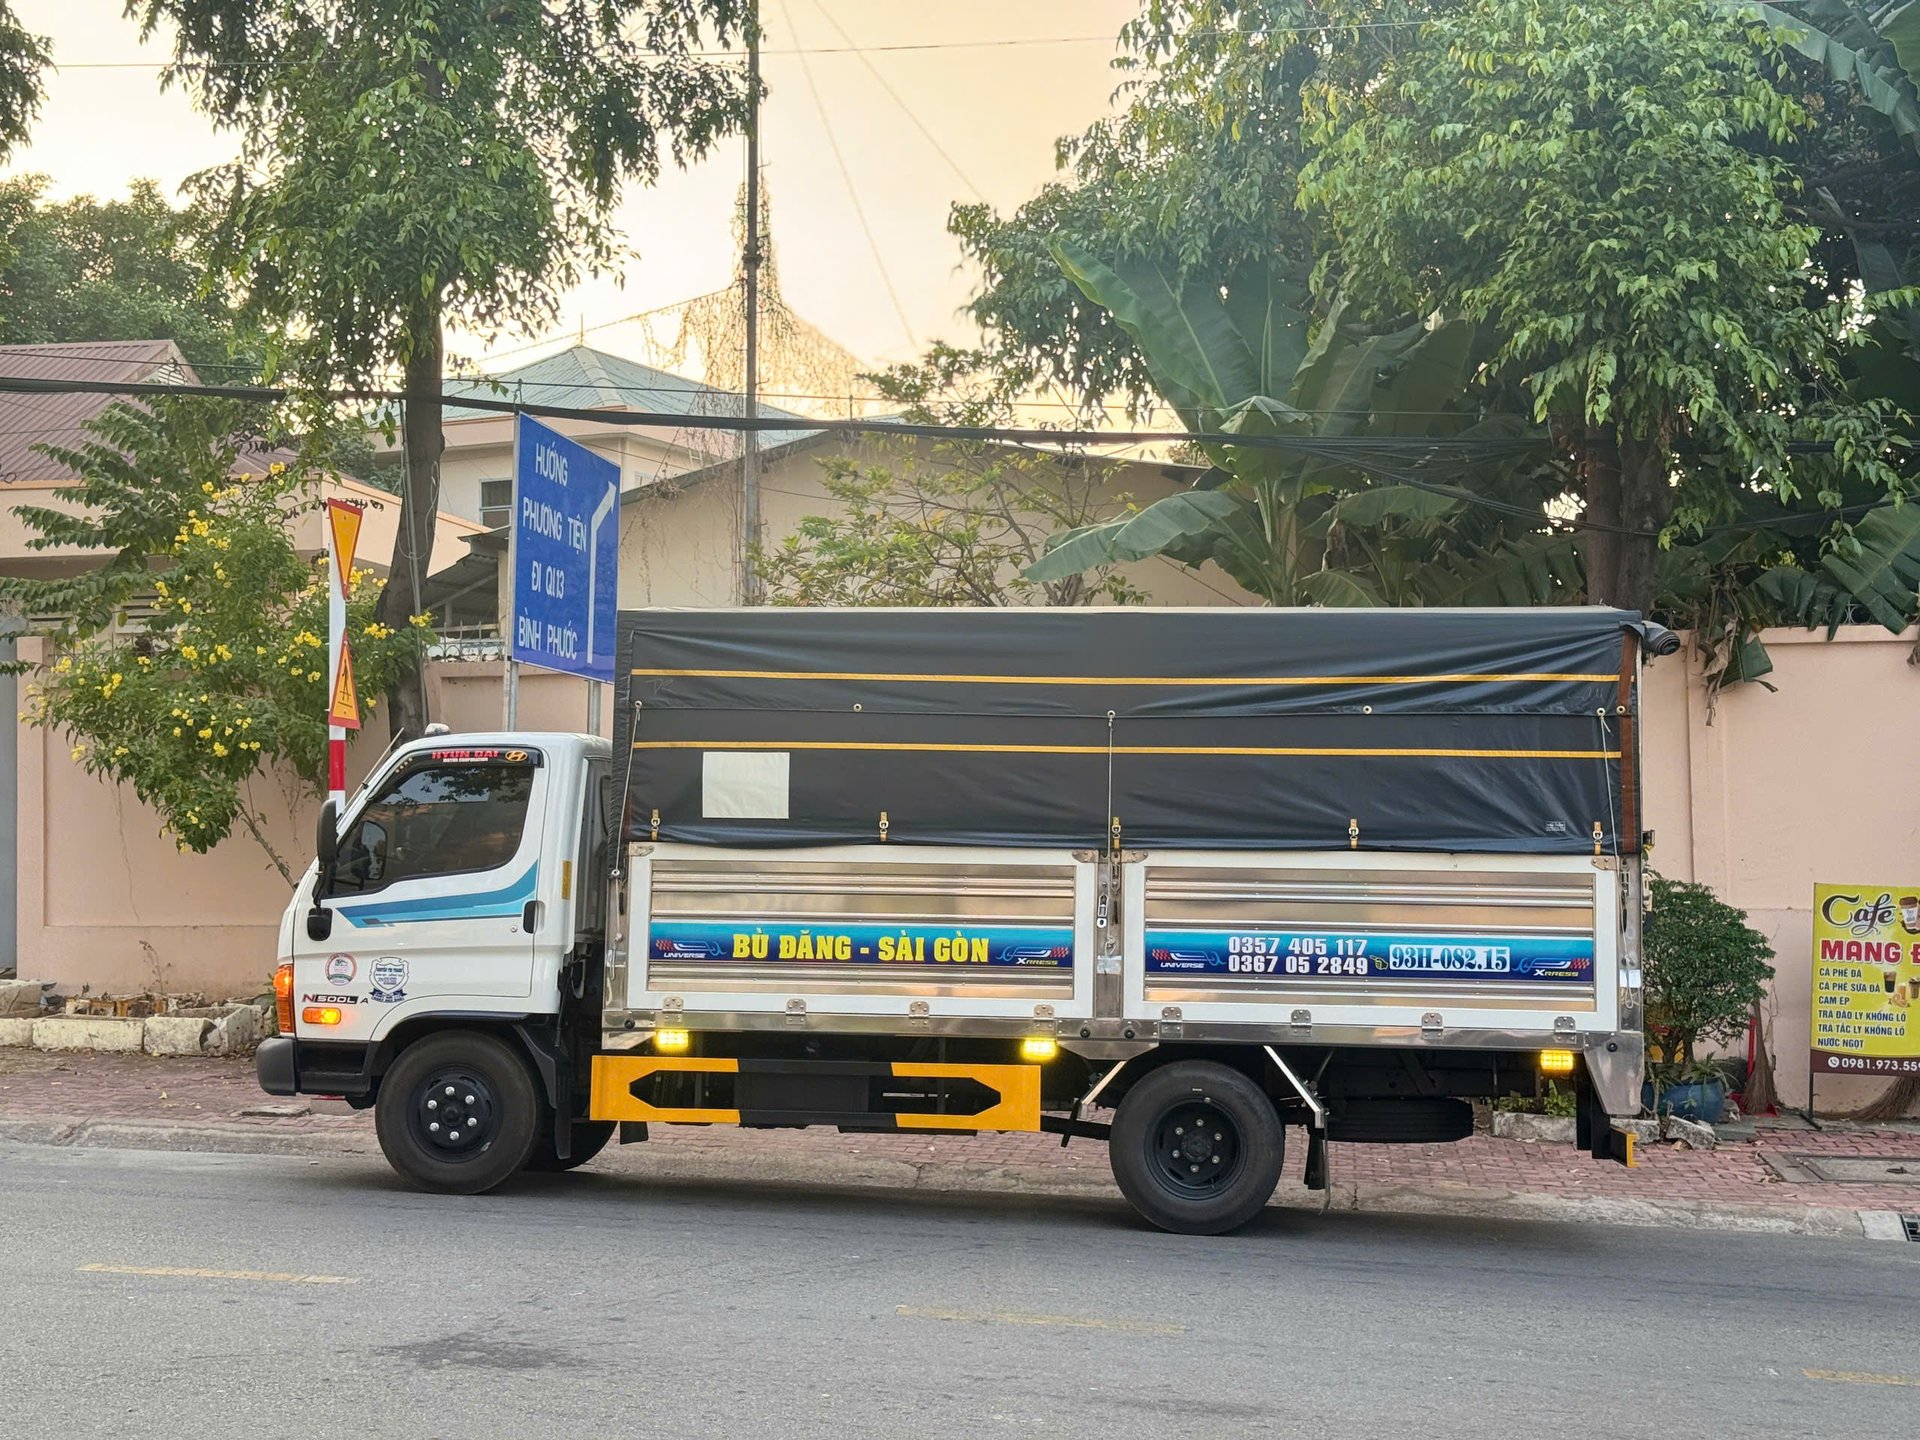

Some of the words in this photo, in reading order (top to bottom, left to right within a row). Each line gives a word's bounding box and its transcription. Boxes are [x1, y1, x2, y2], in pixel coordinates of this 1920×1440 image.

[567, 513, 587, 554] TIỆN
[531, 560, 542, 592] ĐI
[518, 607, 542, 651] BÌNH
[546, 620, 578, 660] PHƯỚC
[1822, 893, 1896, 936] Cafe
[733, 927, 769, 959] BÙ
[778, 929, 851, 960] ĐĂNG
[878, 930, 925, 961] SÀI
[933, 930, 989, 962] GÒN
[1228, 936, 1280, 954] 0357
[1288, 938, 1327, 955] 405
[1335, 939, 1368, 956] 117
[1821, 940, 1901, 963] MANG
[1228, 954, 1279, 973] 0367
[1285, 956, 1310, 974] 05
[1317, 957, 1368, 975] 2849
[1392, 946, 1508, 971] 93H-082.15
[1818, 996, 1837, 1004] CAM
[1855, 1011, 1863, 1020] LY
[1853, 1025, 1862, 1034] LY
[1841, 1058, 1920, 1072] 0981.973.55
